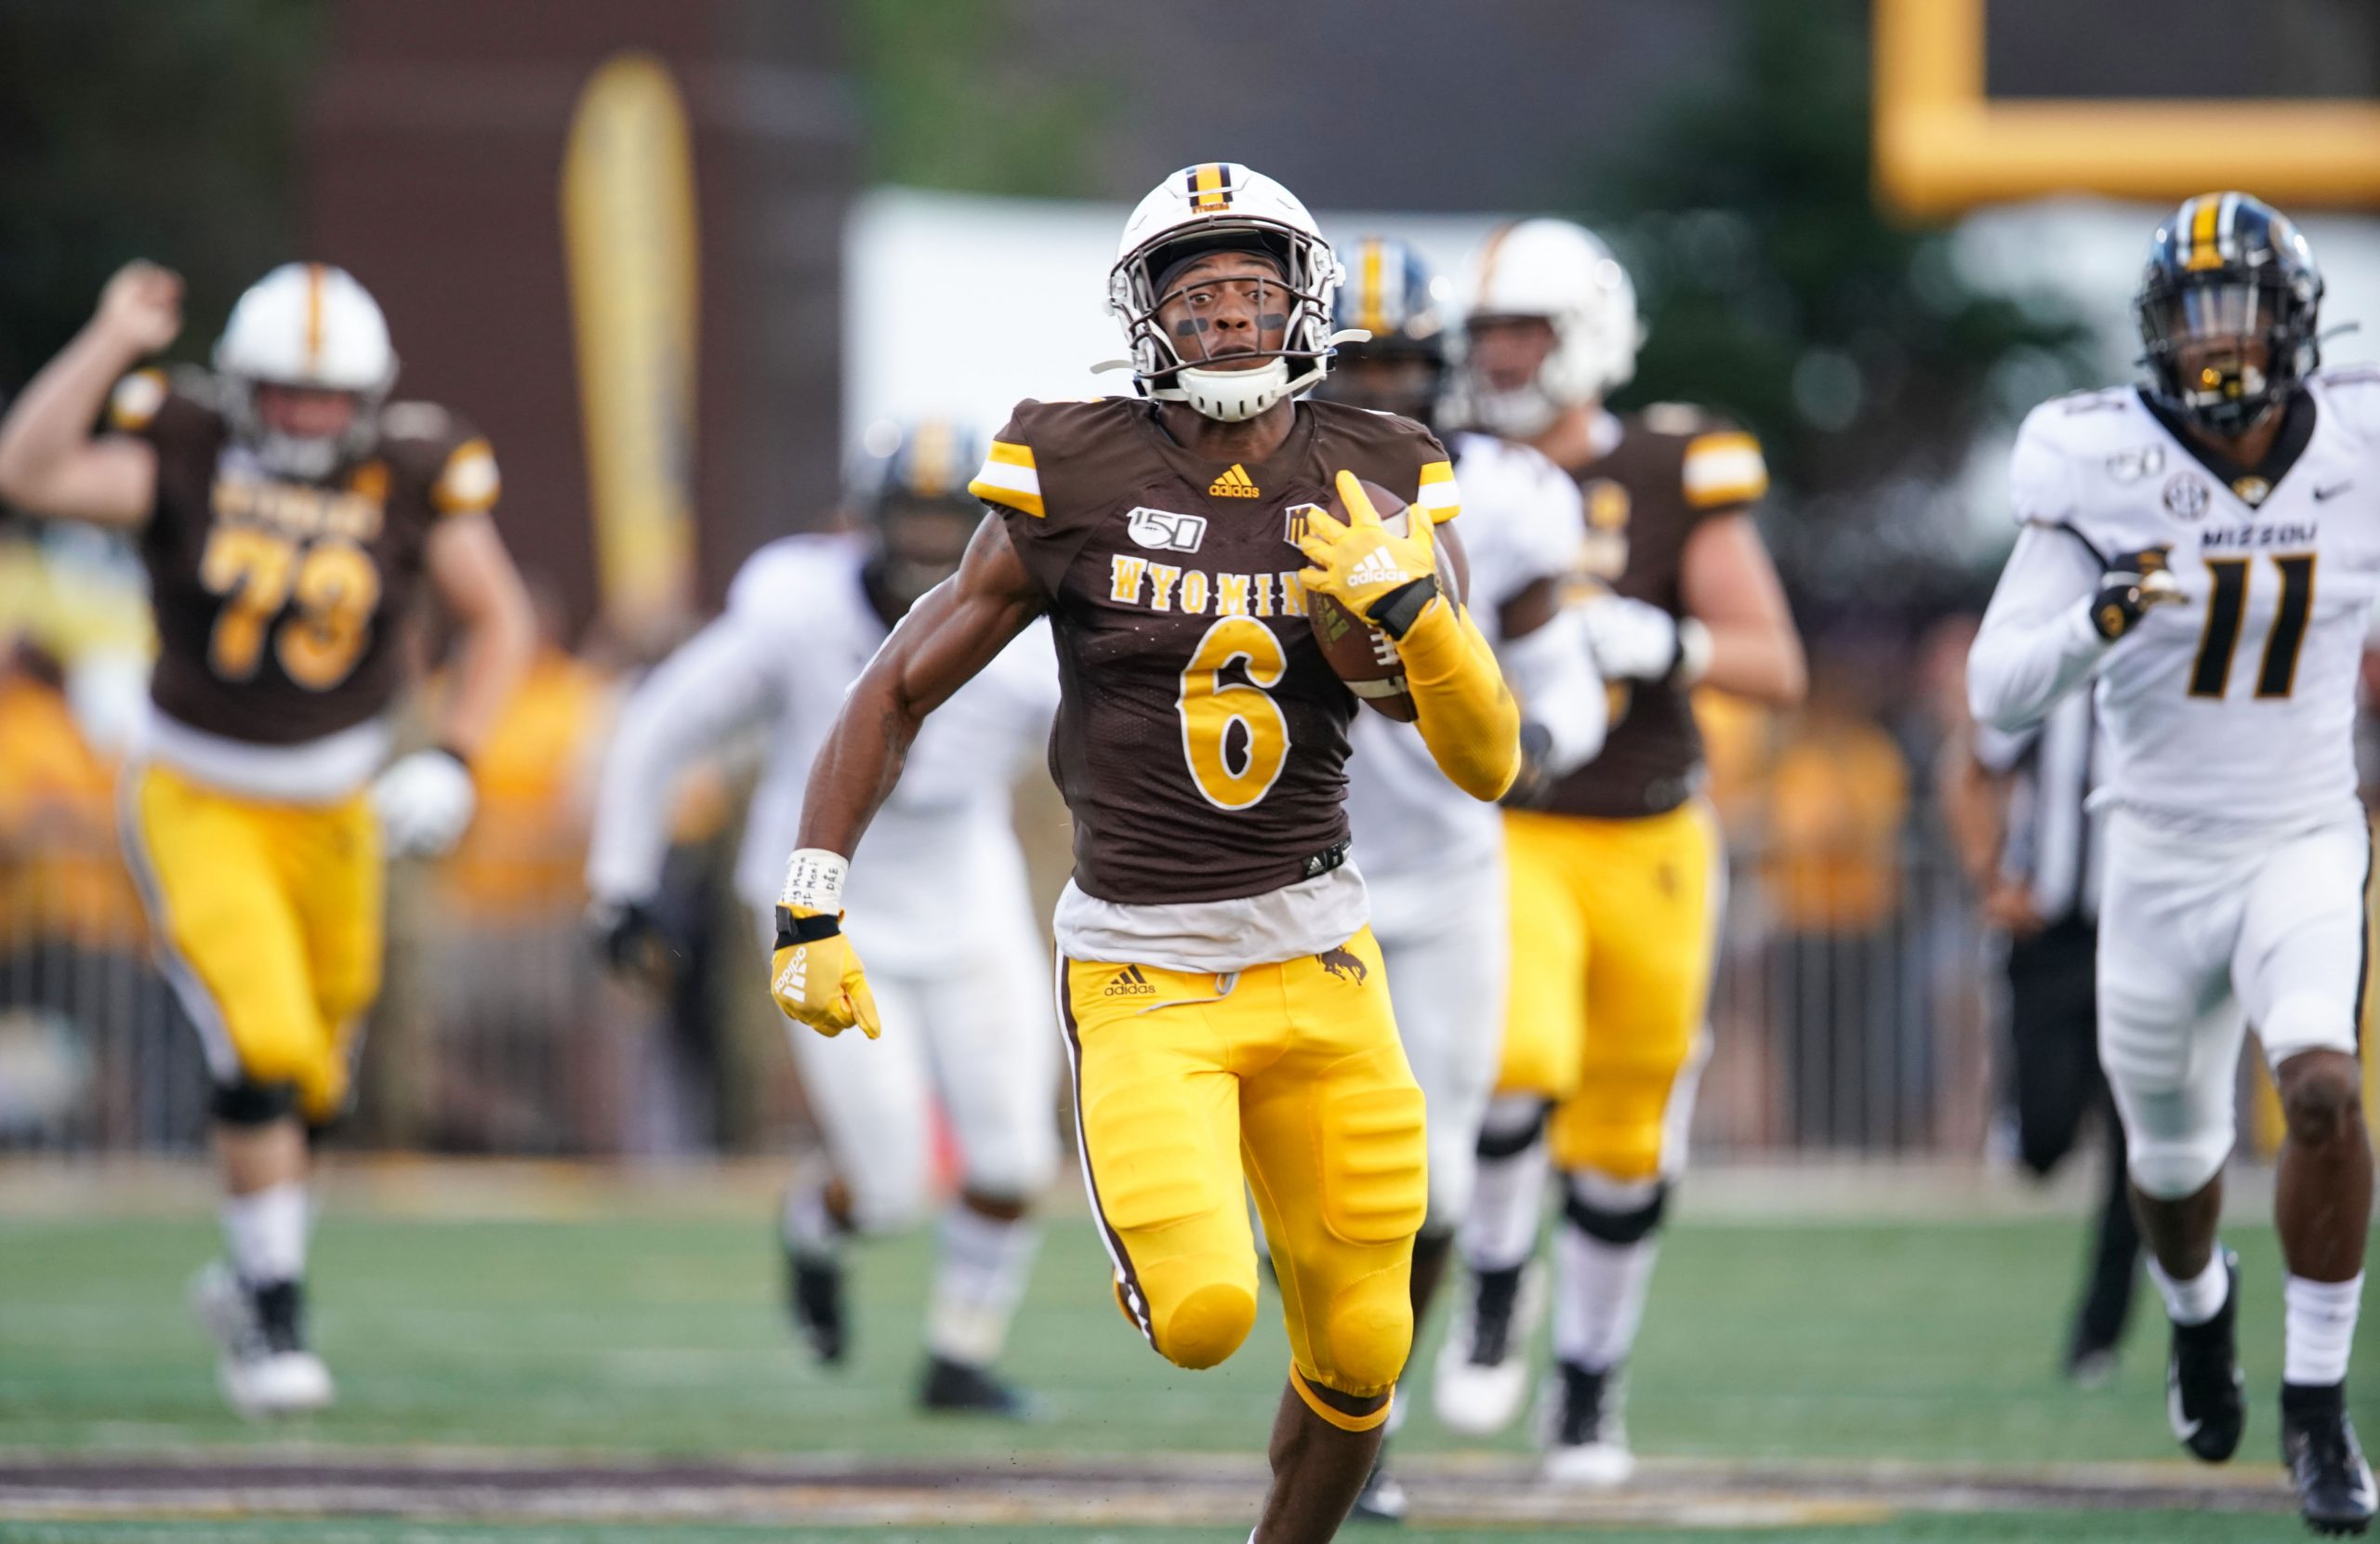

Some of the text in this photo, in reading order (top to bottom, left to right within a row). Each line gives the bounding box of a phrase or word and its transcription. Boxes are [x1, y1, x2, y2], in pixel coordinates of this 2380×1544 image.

[1210, 483, 1260, 498] adidas
[1133, 508, 1205, 550] 150
[2202, 521, 2319, 547] MIZZOU
[1110, 554, 1311, 617] WYOMIN
[1347, 569, 1409, 587] adidas
[2188, 552, 2317, 700] 11
[1175, 614, 1292, 810] 6
[774, 946, 807, 994] adidas
[1104, 983, 1156, 996] adidas
